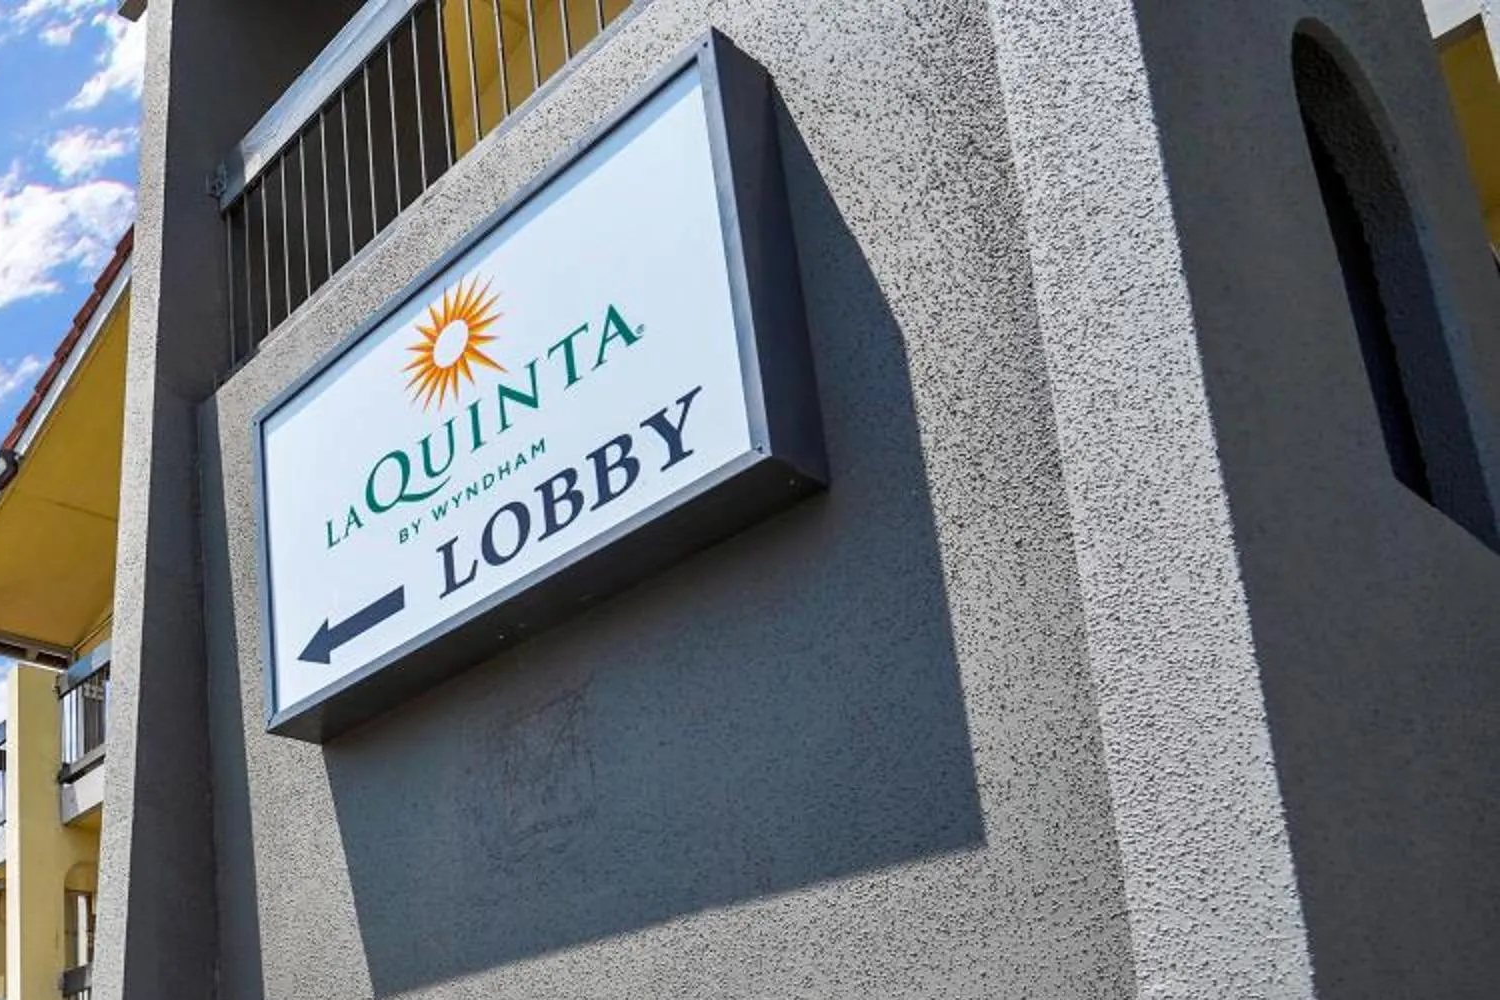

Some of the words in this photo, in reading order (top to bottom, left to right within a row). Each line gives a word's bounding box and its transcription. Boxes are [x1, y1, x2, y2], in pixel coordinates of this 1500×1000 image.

[326, 506, 364, 549] LA
[365, 303, 642, 514] QUINTA
[398, 518, 422, 545] BY
[431, 437, 547, 522] WYNDHAM
[436, 385, 703, 600] LOBBY
